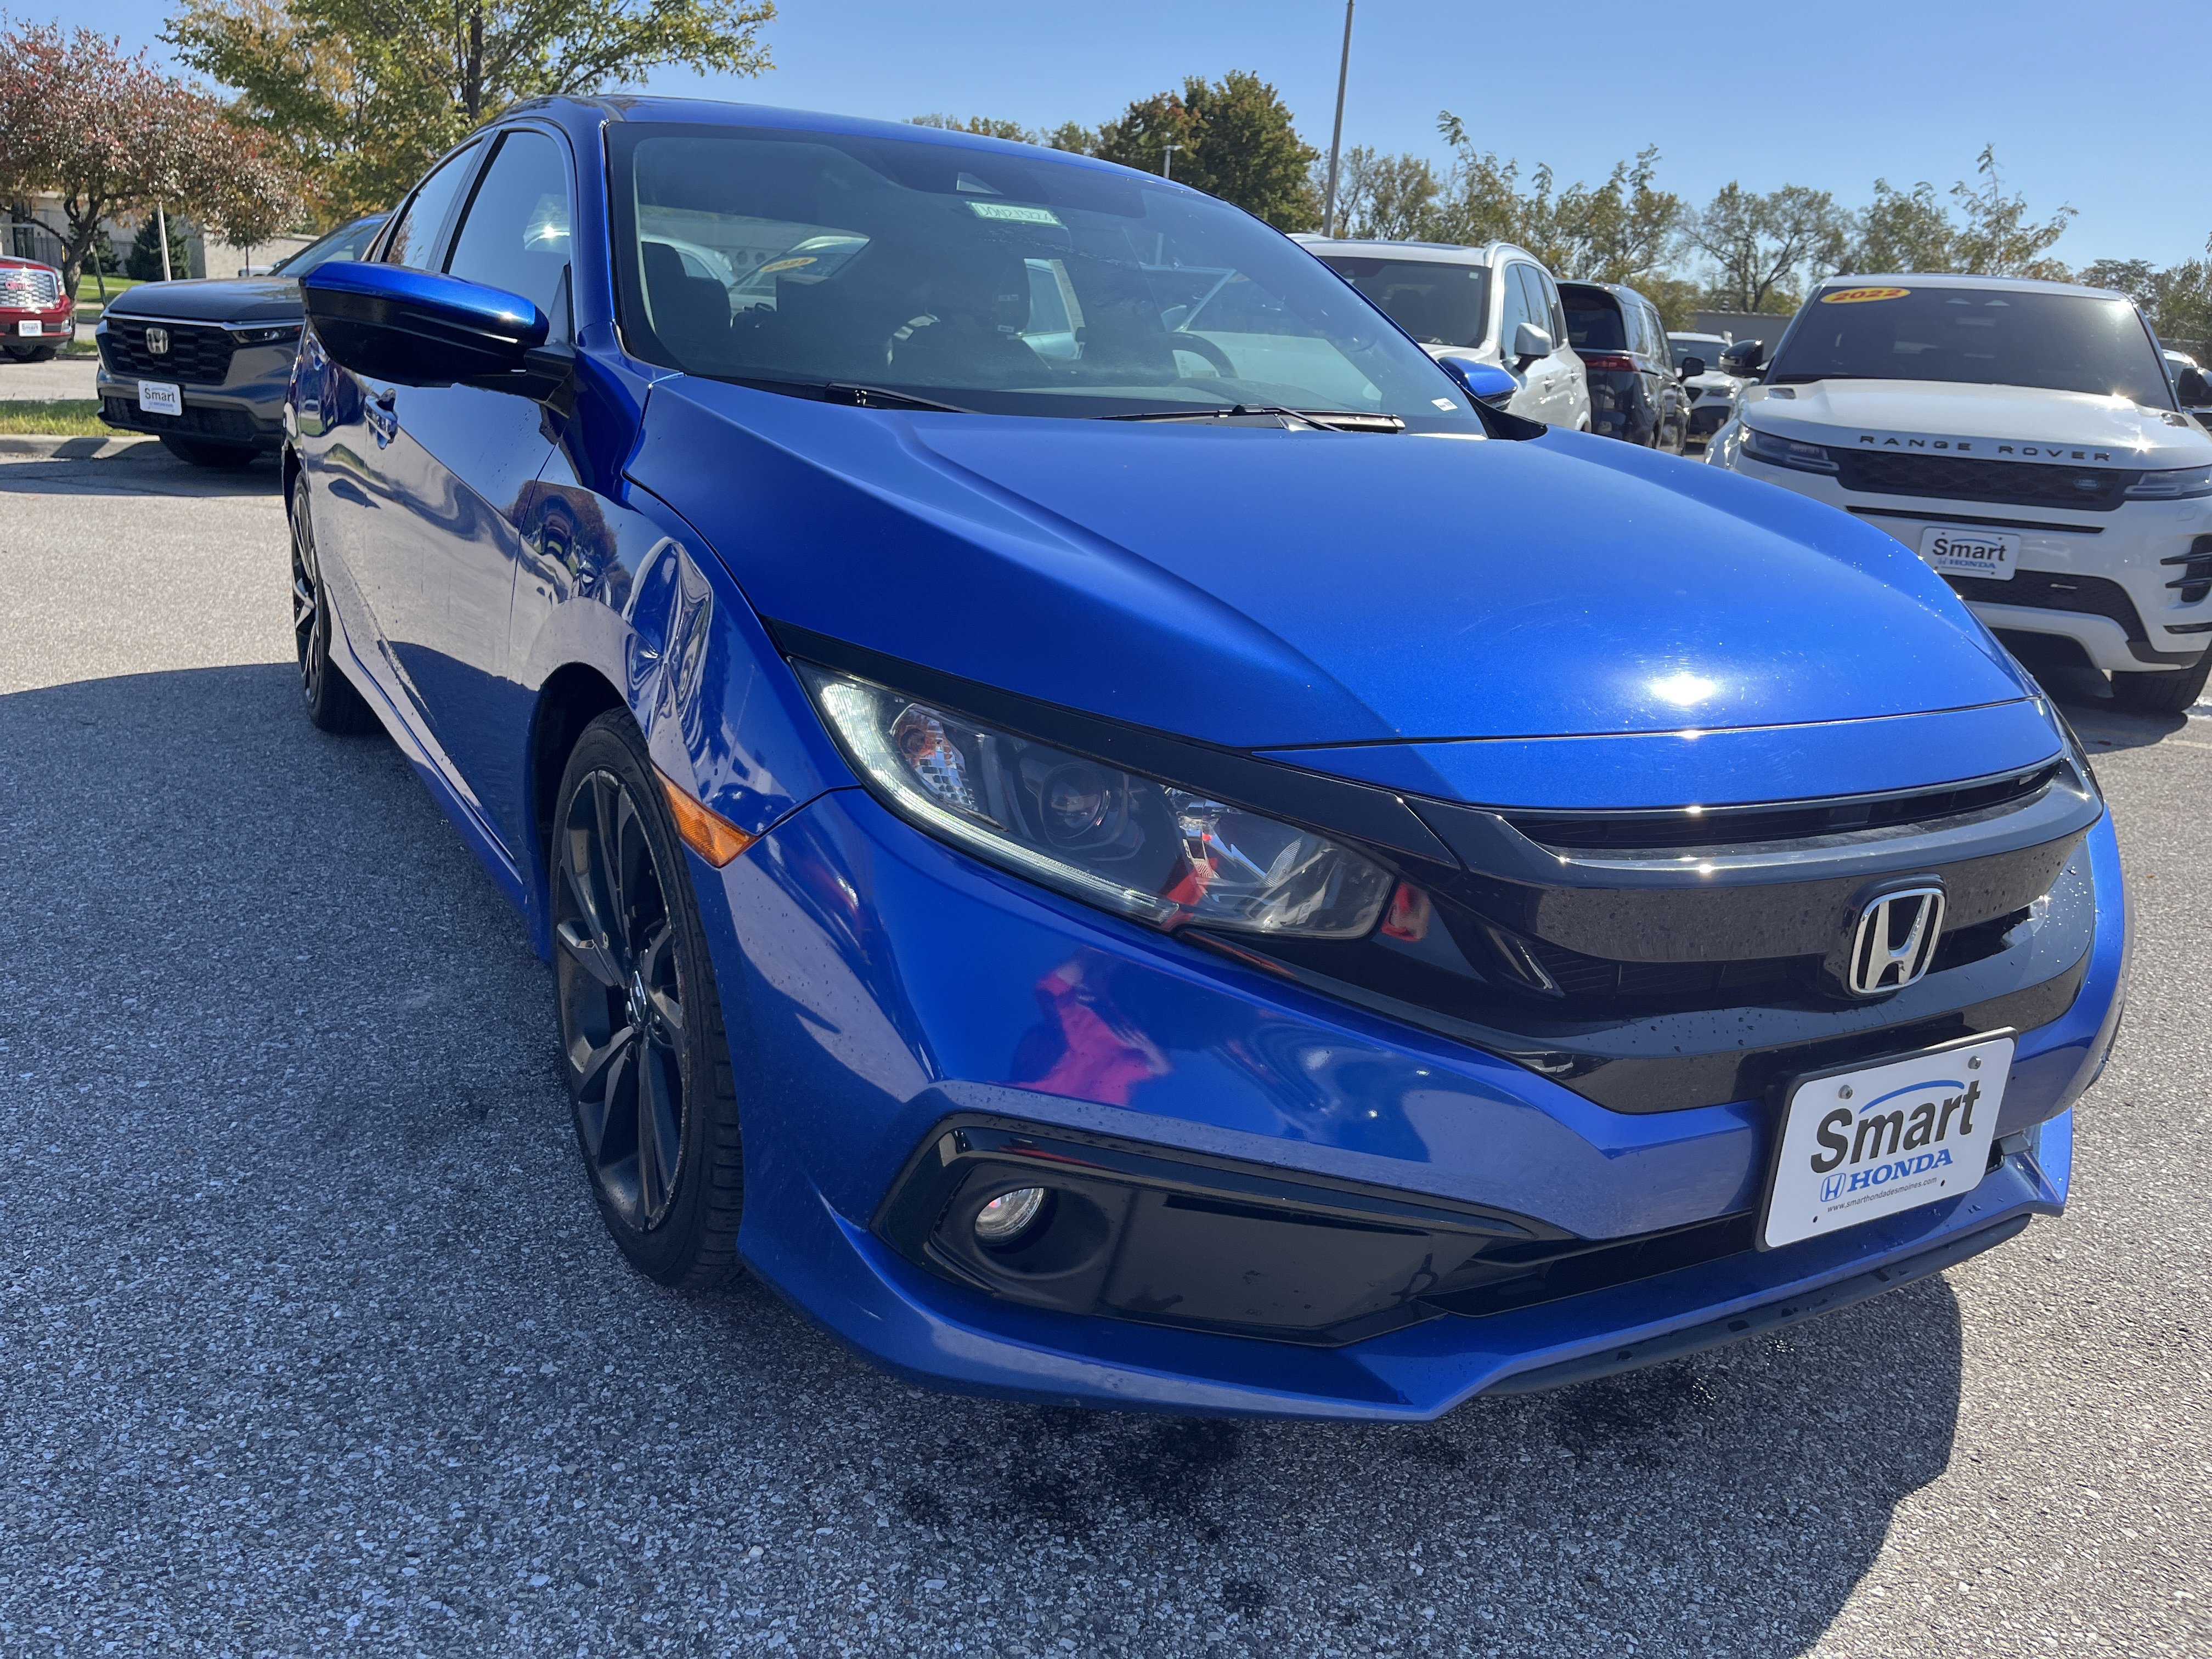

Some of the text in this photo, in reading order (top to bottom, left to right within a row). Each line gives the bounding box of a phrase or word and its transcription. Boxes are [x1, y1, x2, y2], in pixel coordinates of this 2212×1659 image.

[1831, 289, 1902, 301] 2022
[144, 387, 176, 403] Smart
[1859, 436, 2111, 461] RANGE ROVER
[1932, 538, 2007, 561] Smart
[1949, 558, 1997, 569] HONDA
[1810, 1080, 1981, 1173] Smart
[1847, 1148, 1953, 1193] HONDA
[1827, 1177, 1937, 1213] www.smarthondadesmoines.com
